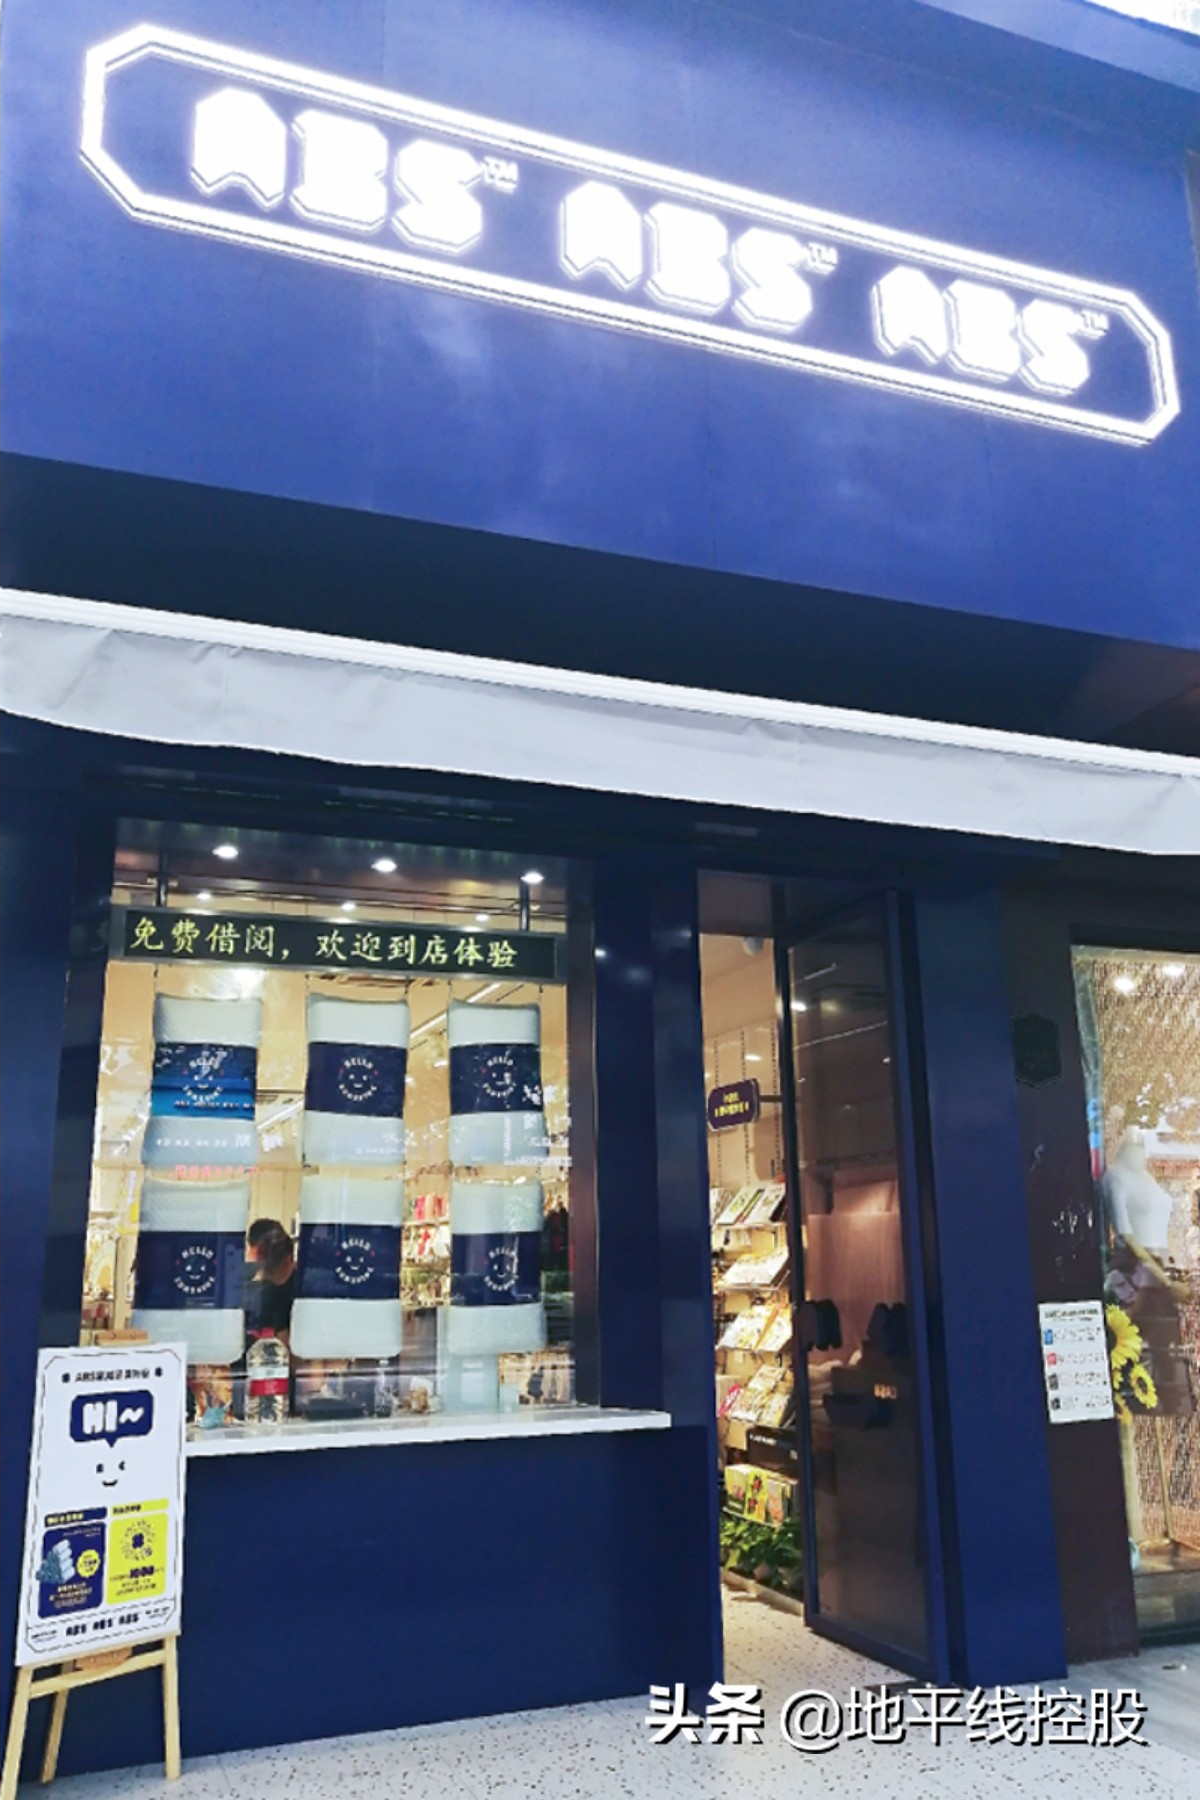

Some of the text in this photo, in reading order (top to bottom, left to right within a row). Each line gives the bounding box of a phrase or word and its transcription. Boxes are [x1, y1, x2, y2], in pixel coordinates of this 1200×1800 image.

[191, 87, 485, 253] ABS
[562, 180, 812, 333] ABS
[873, 265, 1090, 396] ABS
